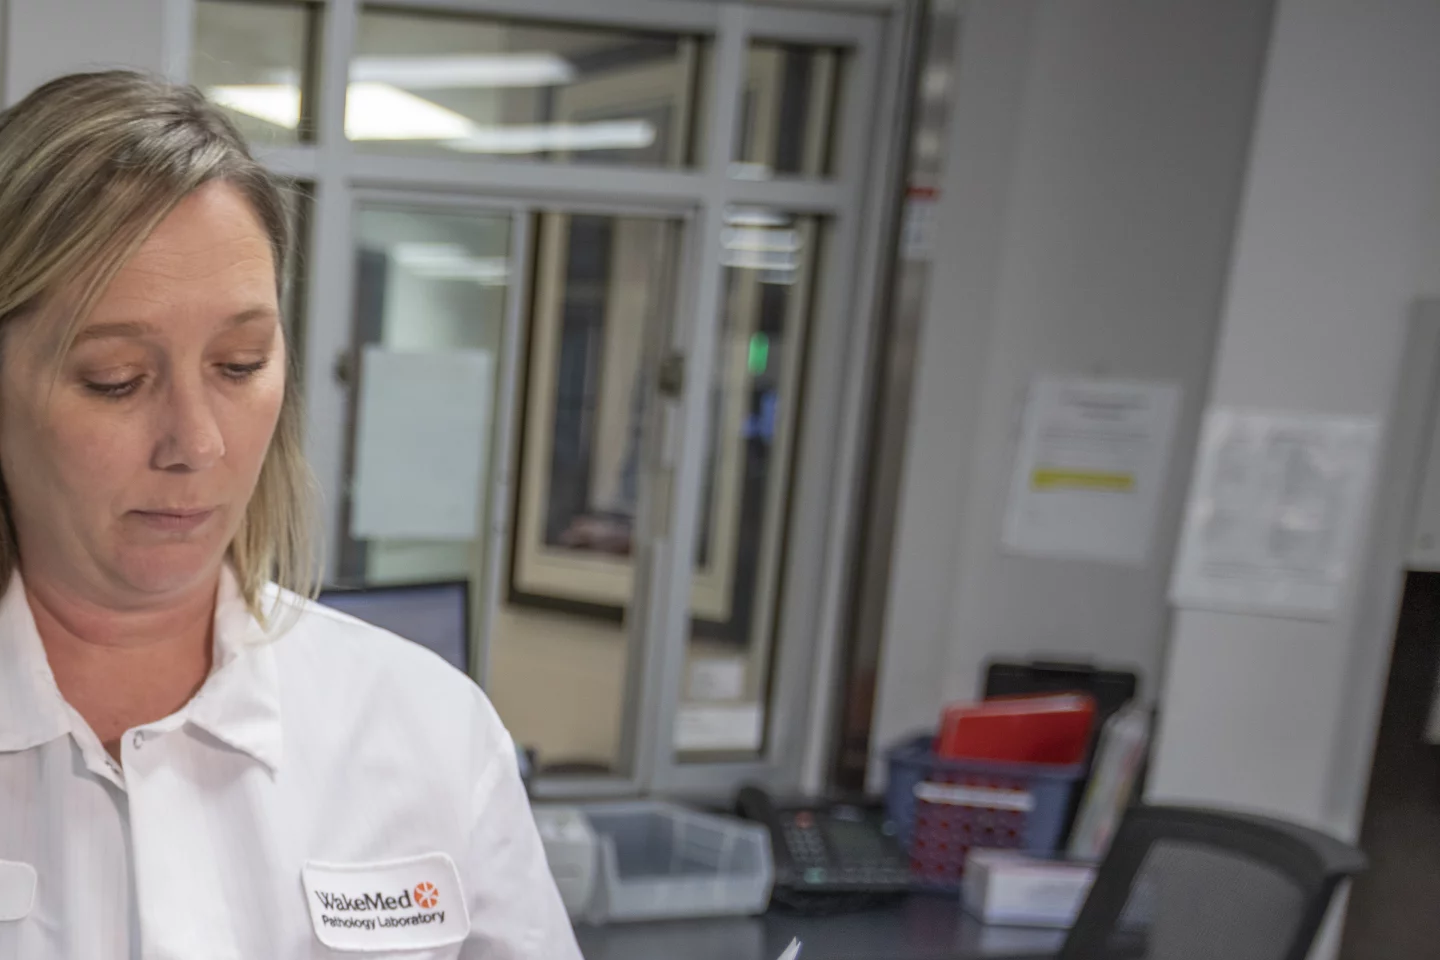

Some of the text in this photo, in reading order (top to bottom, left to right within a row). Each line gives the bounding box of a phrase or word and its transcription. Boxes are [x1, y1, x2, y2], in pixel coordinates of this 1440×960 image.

[314, 889, 414, 912] WakeMed
[321, 910, 445, 930] Pathology Laboratory
